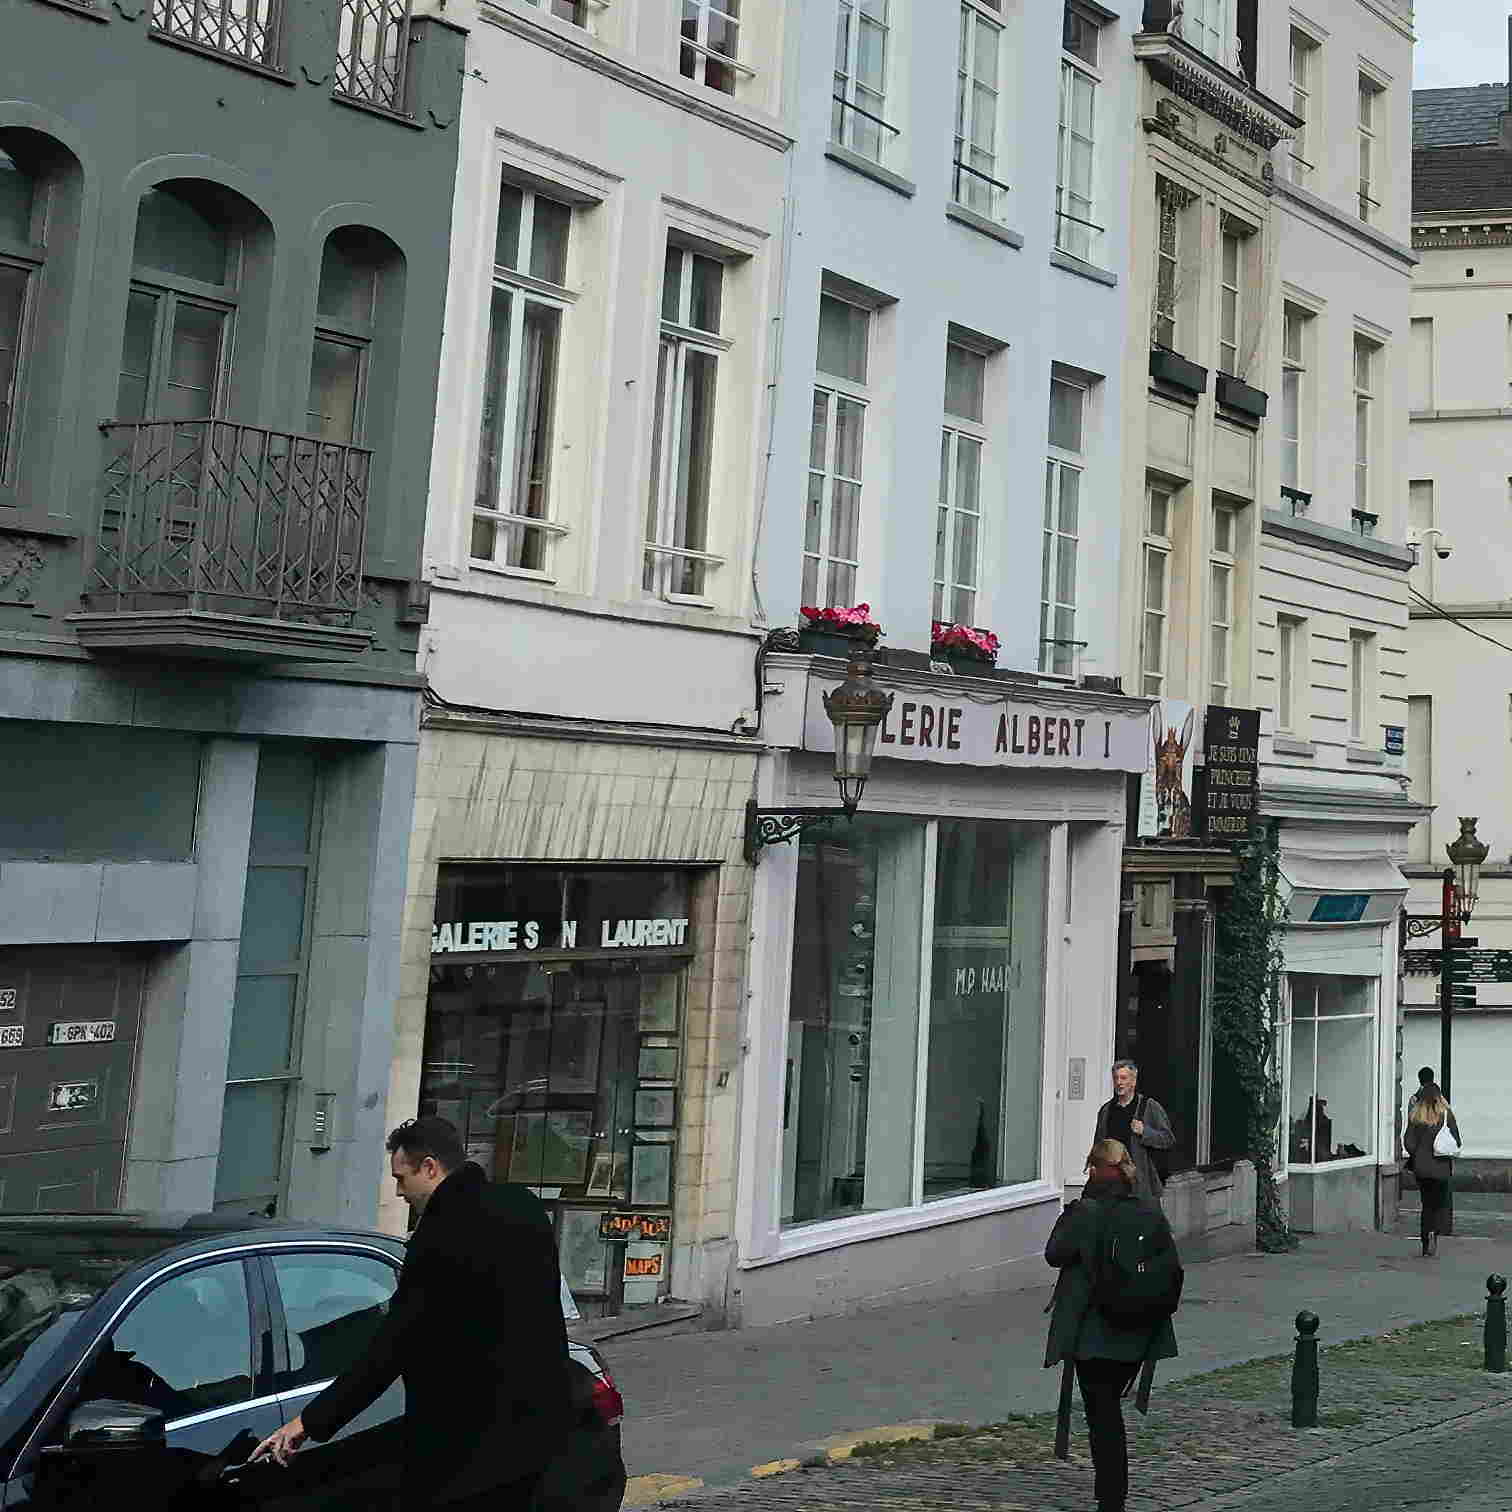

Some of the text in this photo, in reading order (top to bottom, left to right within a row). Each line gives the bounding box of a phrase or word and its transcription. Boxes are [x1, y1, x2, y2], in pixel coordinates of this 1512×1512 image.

[881, 702, 1112, 759] LERIE ALBERT I
[432, 920, 517, 953] GALERIE
[601, 918, 689, 948] LAURENT
